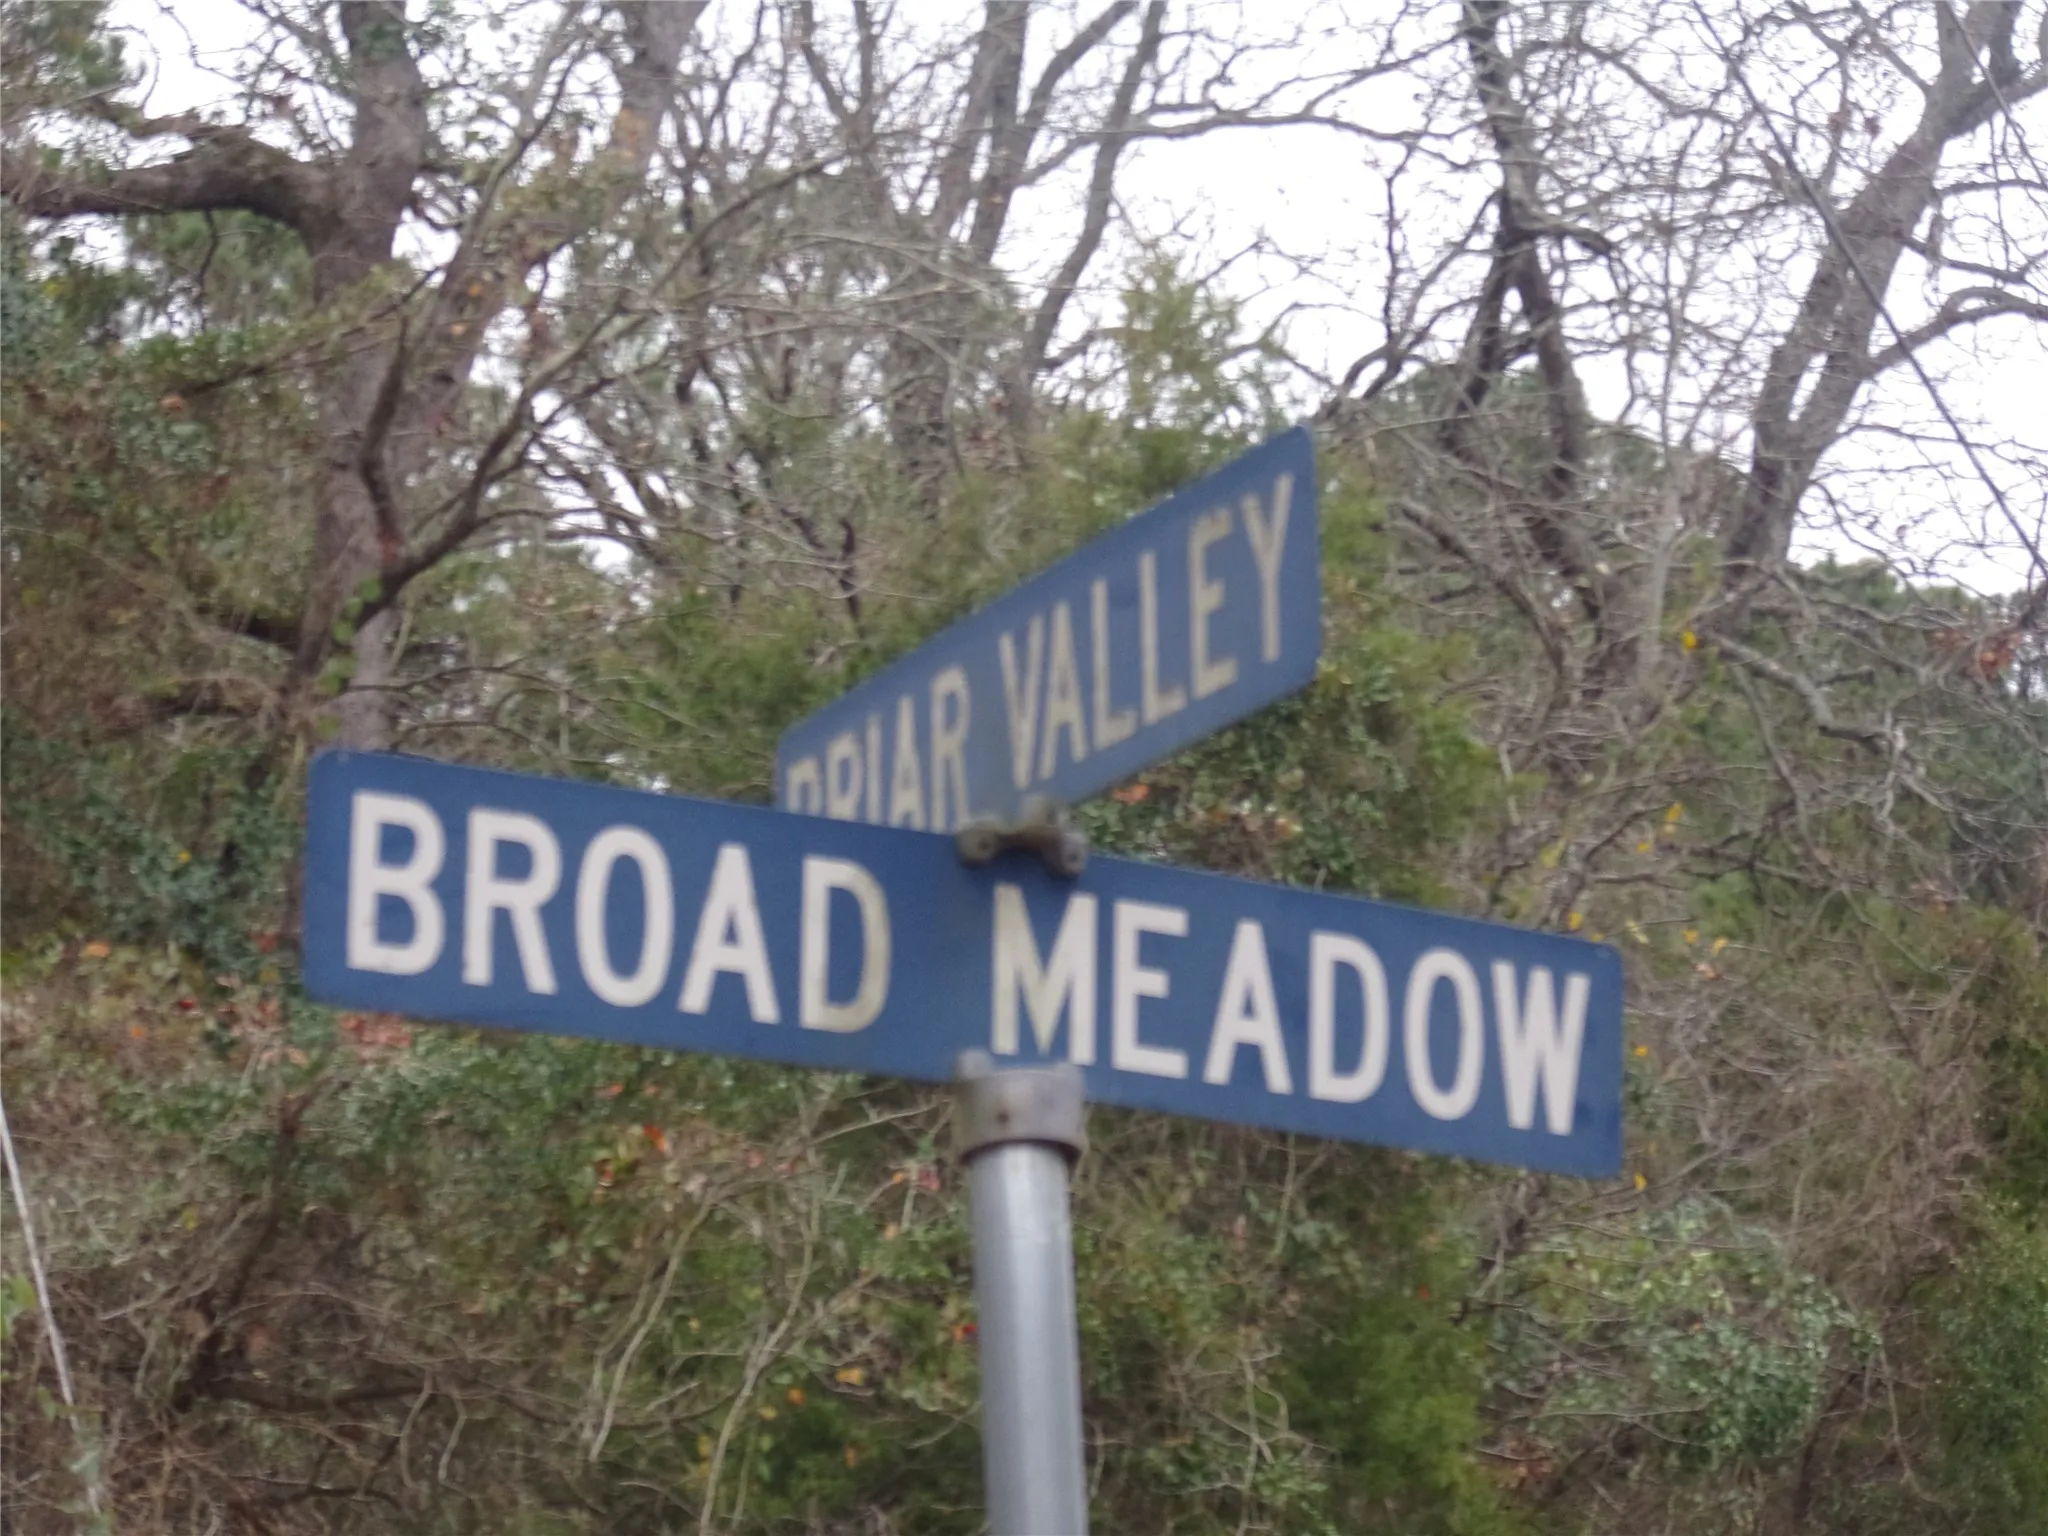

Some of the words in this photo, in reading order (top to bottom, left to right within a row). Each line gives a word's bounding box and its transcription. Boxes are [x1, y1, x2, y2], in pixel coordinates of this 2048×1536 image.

[1000, 474, 1293, 790] VALLEY
[346, 789, 890, 1033] BROAD
[991, 884, 1591, 1136] MEADOW
